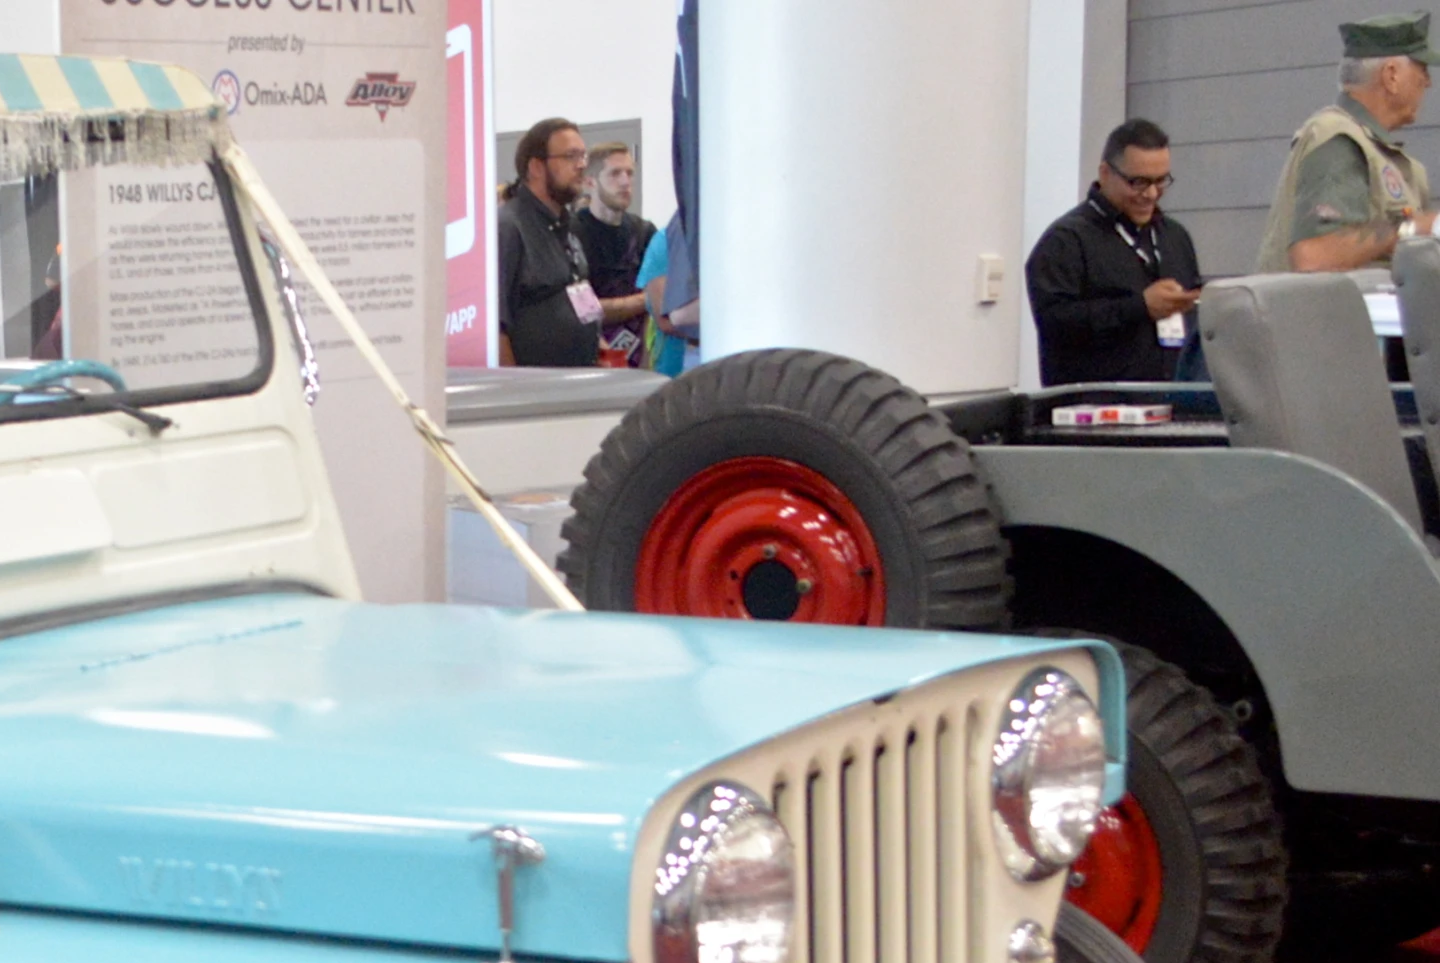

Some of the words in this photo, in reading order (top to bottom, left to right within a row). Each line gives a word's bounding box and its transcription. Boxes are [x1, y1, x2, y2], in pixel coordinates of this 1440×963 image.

[228, 34, 287, 53] presented
[291, 34, 305, 54] by
[244, 81, 328, 107] Omix-ADA
[351, 82, 412, 100] Alloy
[108, 184, 143, 204] 1948
[146, 182, 194, 203] WILLYS
